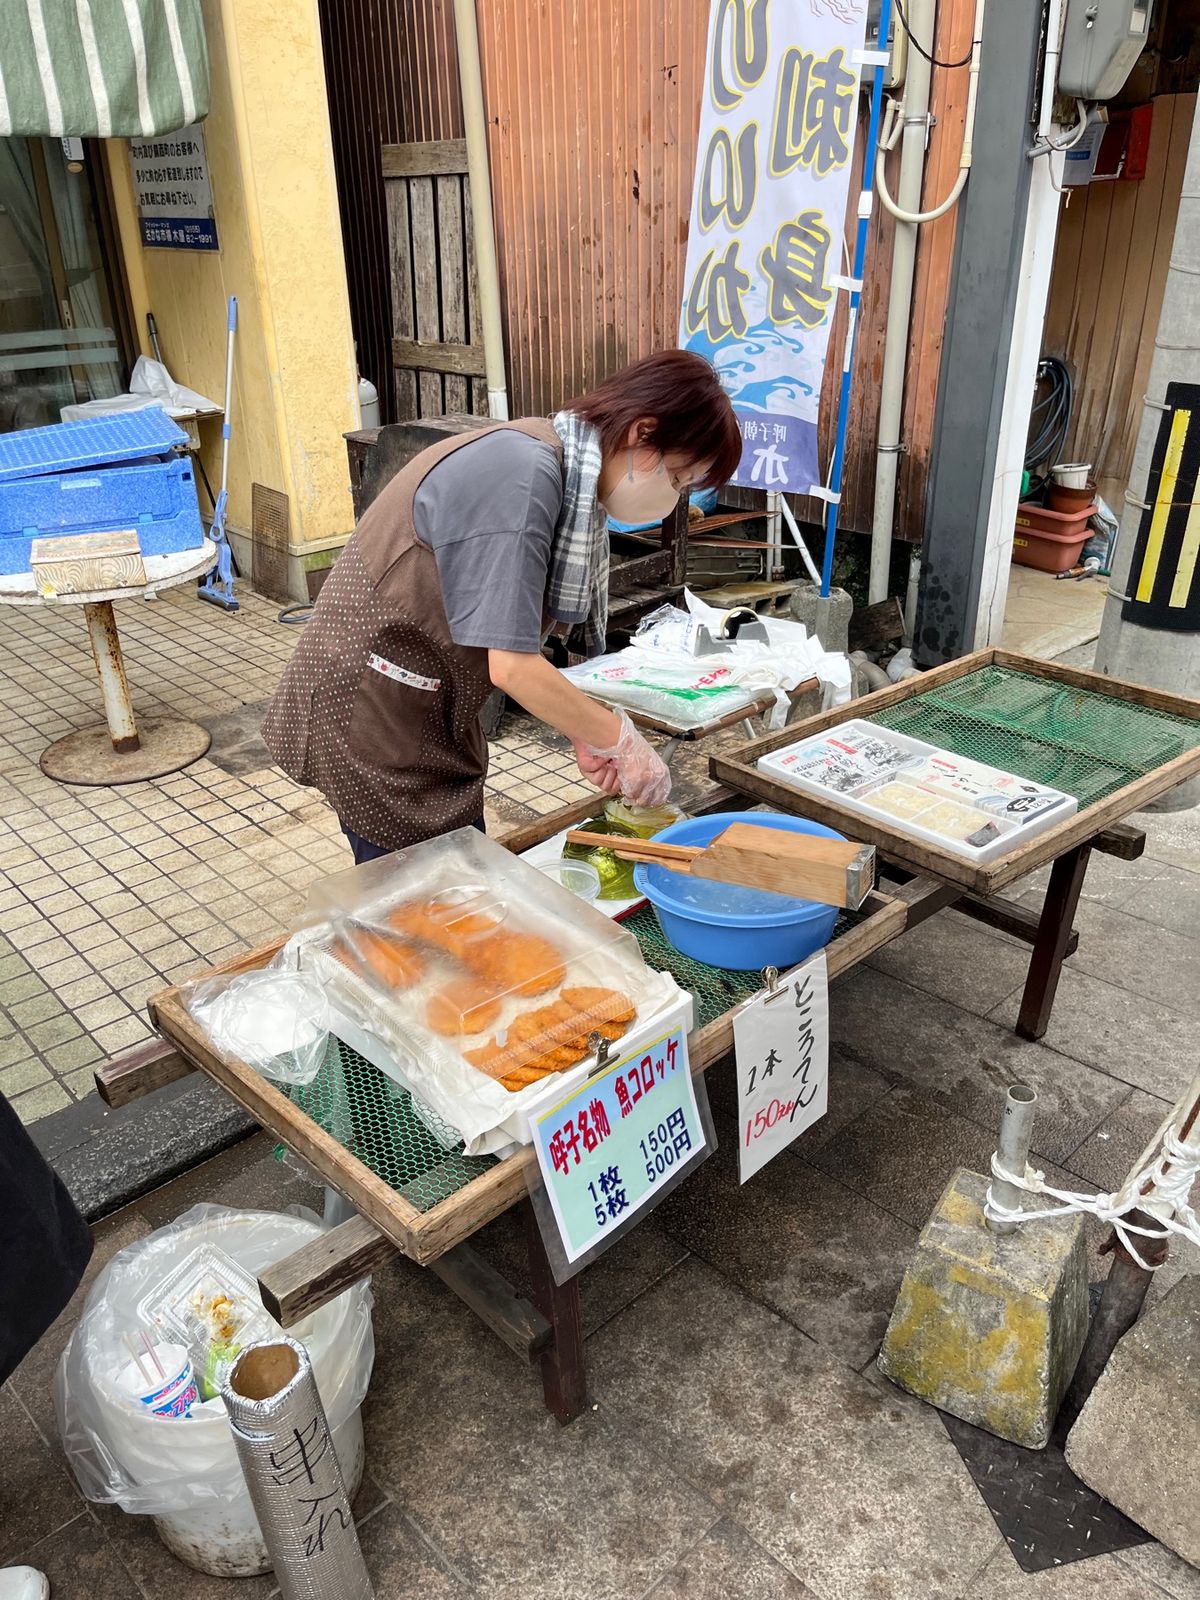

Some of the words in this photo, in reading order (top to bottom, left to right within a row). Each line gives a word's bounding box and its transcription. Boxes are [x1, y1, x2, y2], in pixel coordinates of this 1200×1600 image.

[548, 1098, 611, 1175] 呼子名物
[615, 1038, 678, 1119] 魚コロッケ
[790, 975, 818, 1123] ところてん
[587, 1165, 622, 1202] 1枚
[639, 1107, 686, 1160] 150円
[595, 1188, 630, 1227] 5枚
[645, 1128, 692, 1183] 500円
